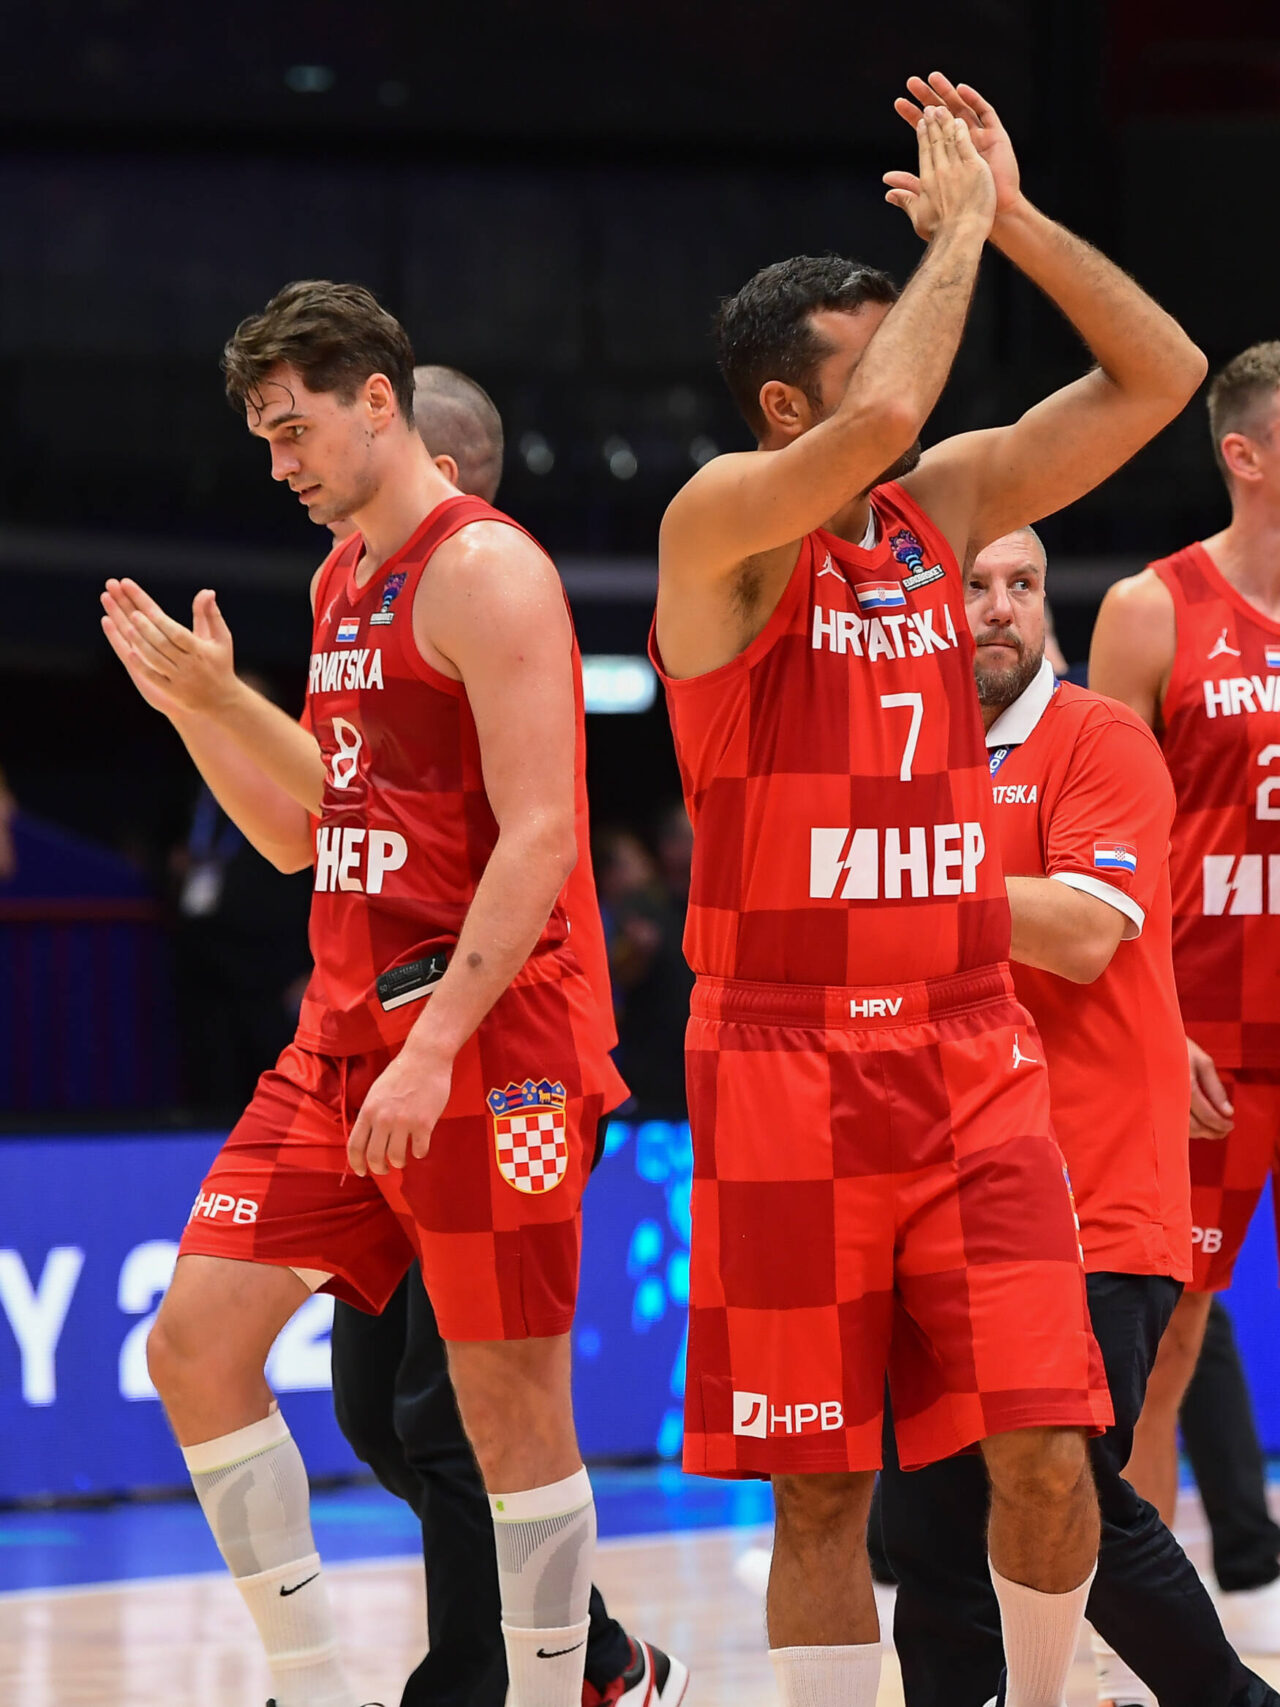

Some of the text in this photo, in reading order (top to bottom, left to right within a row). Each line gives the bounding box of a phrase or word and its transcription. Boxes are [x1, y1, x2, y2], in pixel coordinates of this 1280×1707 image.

[309, 650, 384, 694] RVATSKA
[331, 717, 363, 789] 8
[880, 692, 924, 782] 7
[315, 827, 408, 894] HEP
[885, 821, 986, 899] HEP
[849, 997, 903, 1018] HRV
[194, 1192, 259, 1224] HPB
[1191, 1226, 1223, 1254] PB
[770, 1400, 844, 1434] HPB
